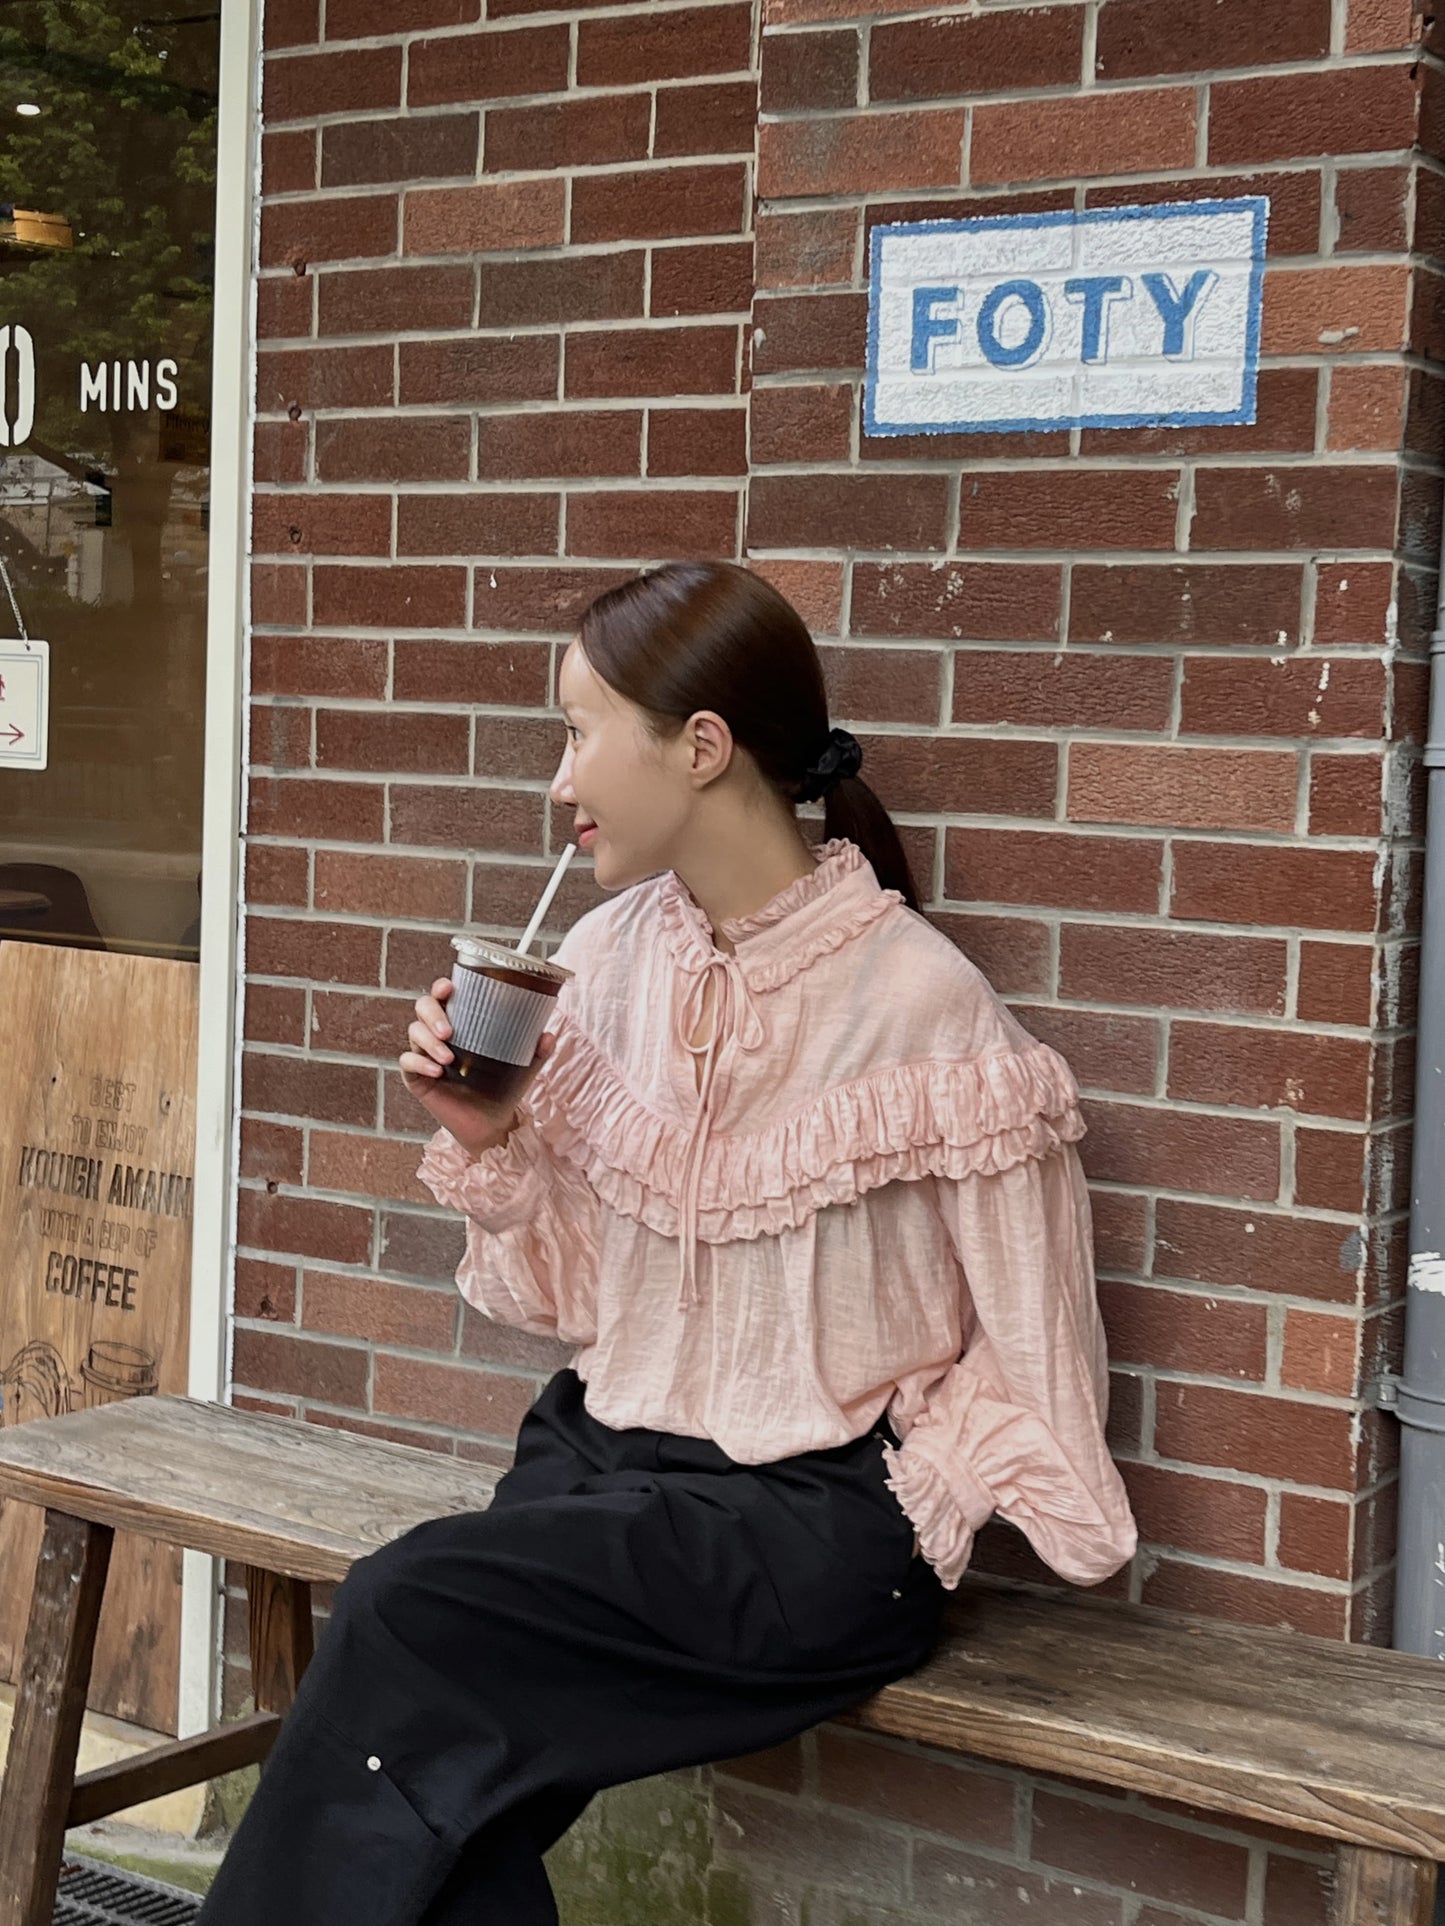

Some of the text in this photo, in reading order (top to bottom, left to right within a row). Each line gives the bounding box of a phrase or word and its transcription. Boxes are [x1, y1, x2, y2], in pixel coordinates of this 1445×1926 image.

[910, 269, 1220, 375] FOTY
[80, 359, 179, 413] MINS
[72, 1114, 148, 1156] TO ENJOY
[18, 1146, 192, 1219] KOUIGN AMANN
[40, 1208, 158, 1258] WITH A CUP OF
[46, 1251, 139, 1311] COFFEE
